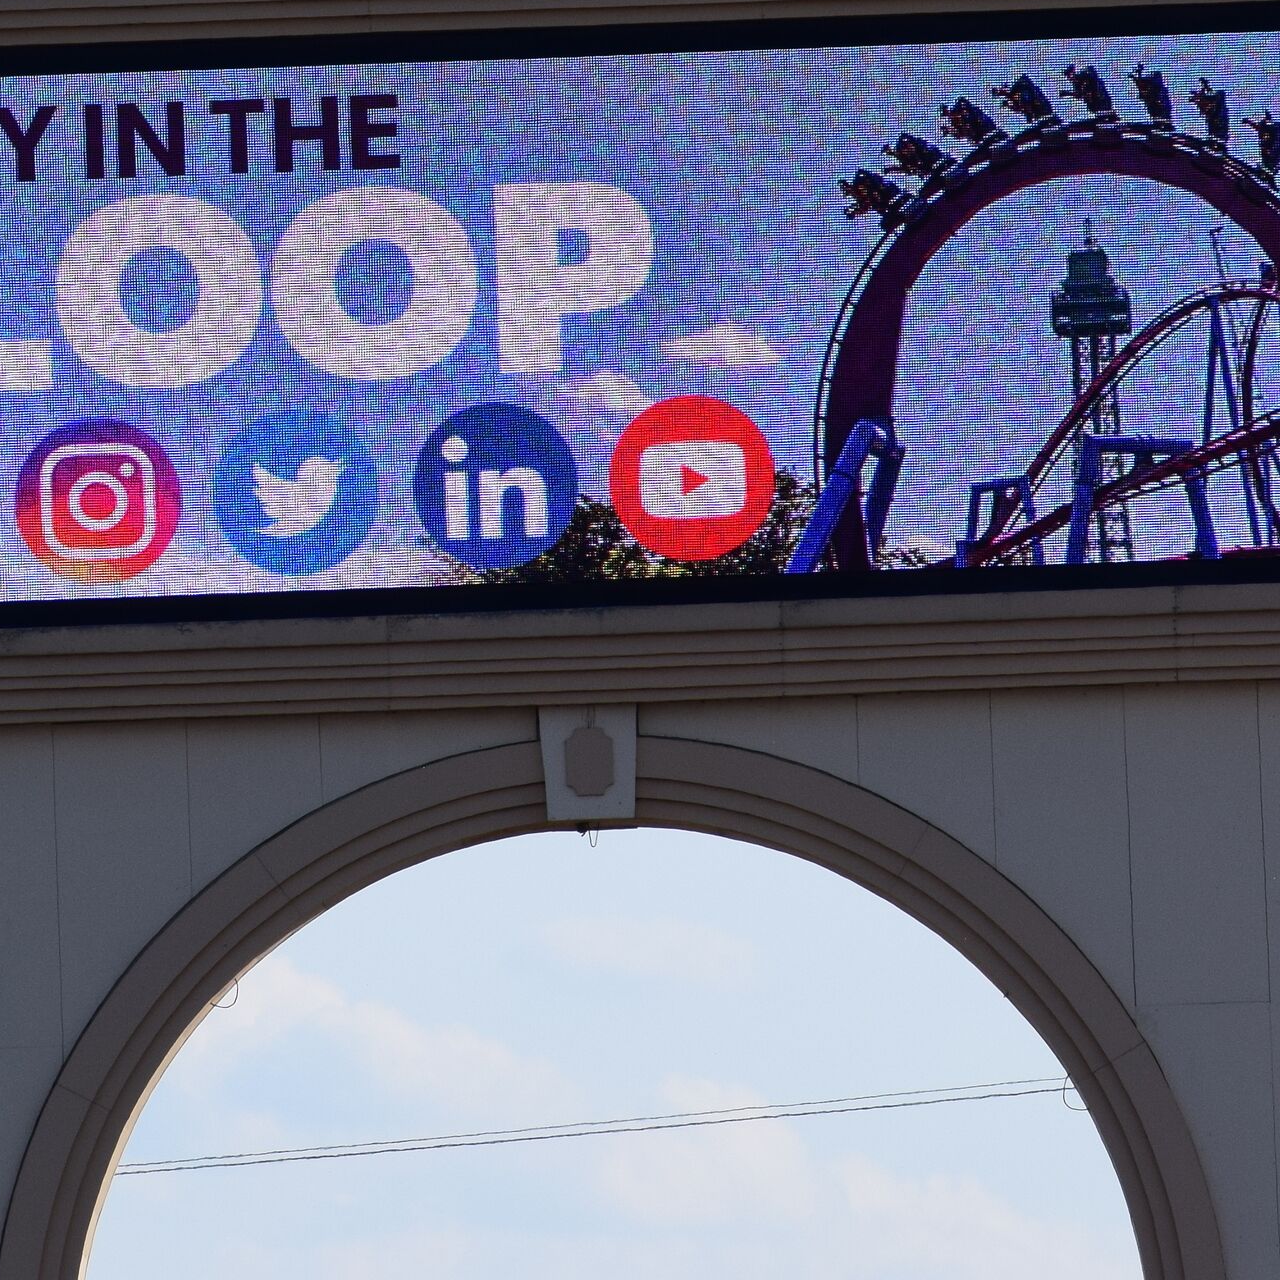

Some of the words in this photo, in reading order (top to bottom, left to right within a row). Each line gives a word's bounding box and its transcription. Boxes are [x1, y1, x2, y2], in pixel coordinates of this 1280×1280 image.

[84, 101, 187, 180] IN
[210, 93, 402, 175] THE
[439, 434, 549, 542] in
